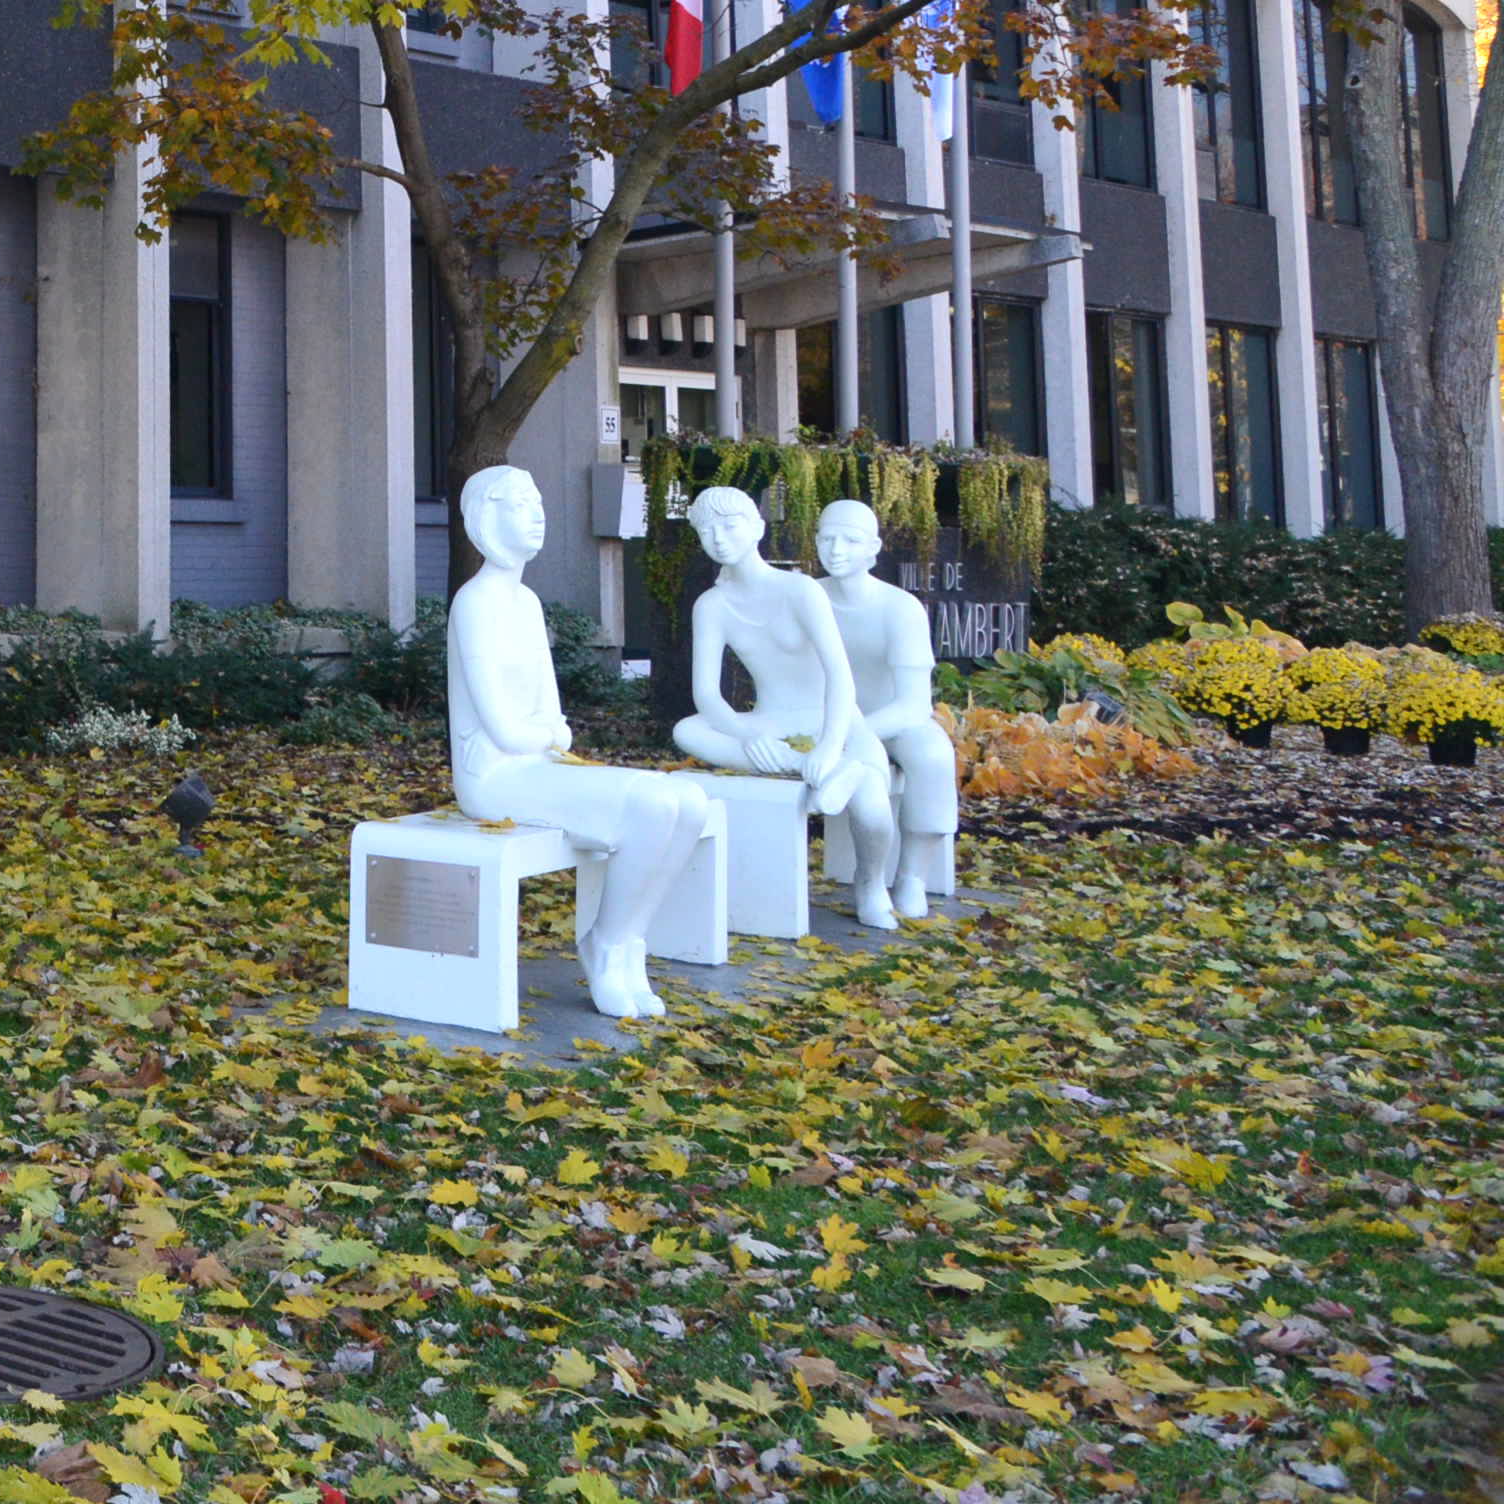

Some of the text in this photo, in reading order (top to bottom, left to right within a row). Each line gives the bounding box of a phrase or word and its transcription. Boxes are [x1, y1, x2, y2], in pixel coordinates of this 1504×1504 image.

[604, 416, 617, 433] 55
[944, 562, 964, 592] DE
[926, 601, 1030, 658] AMBERT
